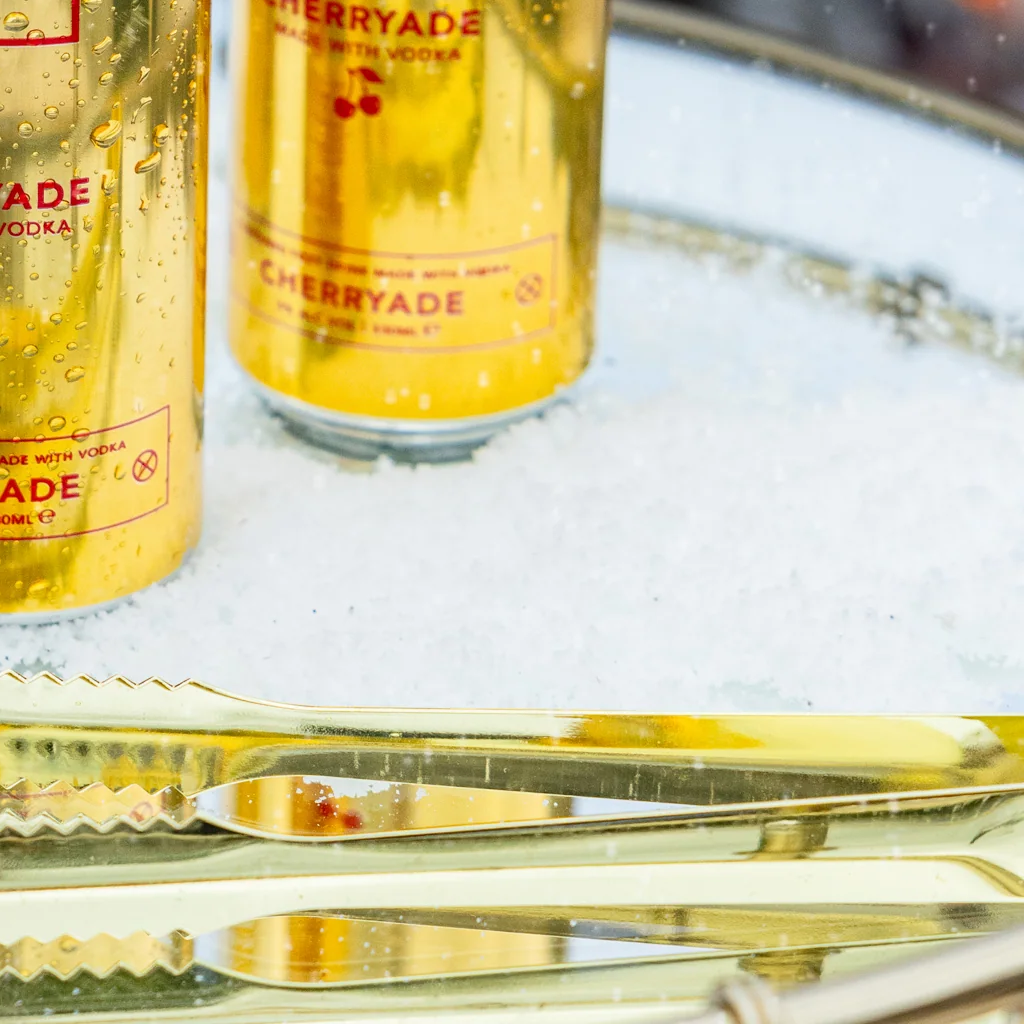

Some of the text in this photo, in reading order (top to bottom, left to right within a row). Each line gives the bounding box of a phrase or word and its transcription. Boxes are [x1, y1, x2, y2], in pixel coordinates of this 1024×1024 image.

[260, 257, 464, 317] CHERRYADE
[35, 451, 73, 464] WITH
[78, 440, 127, 460] VODKA
